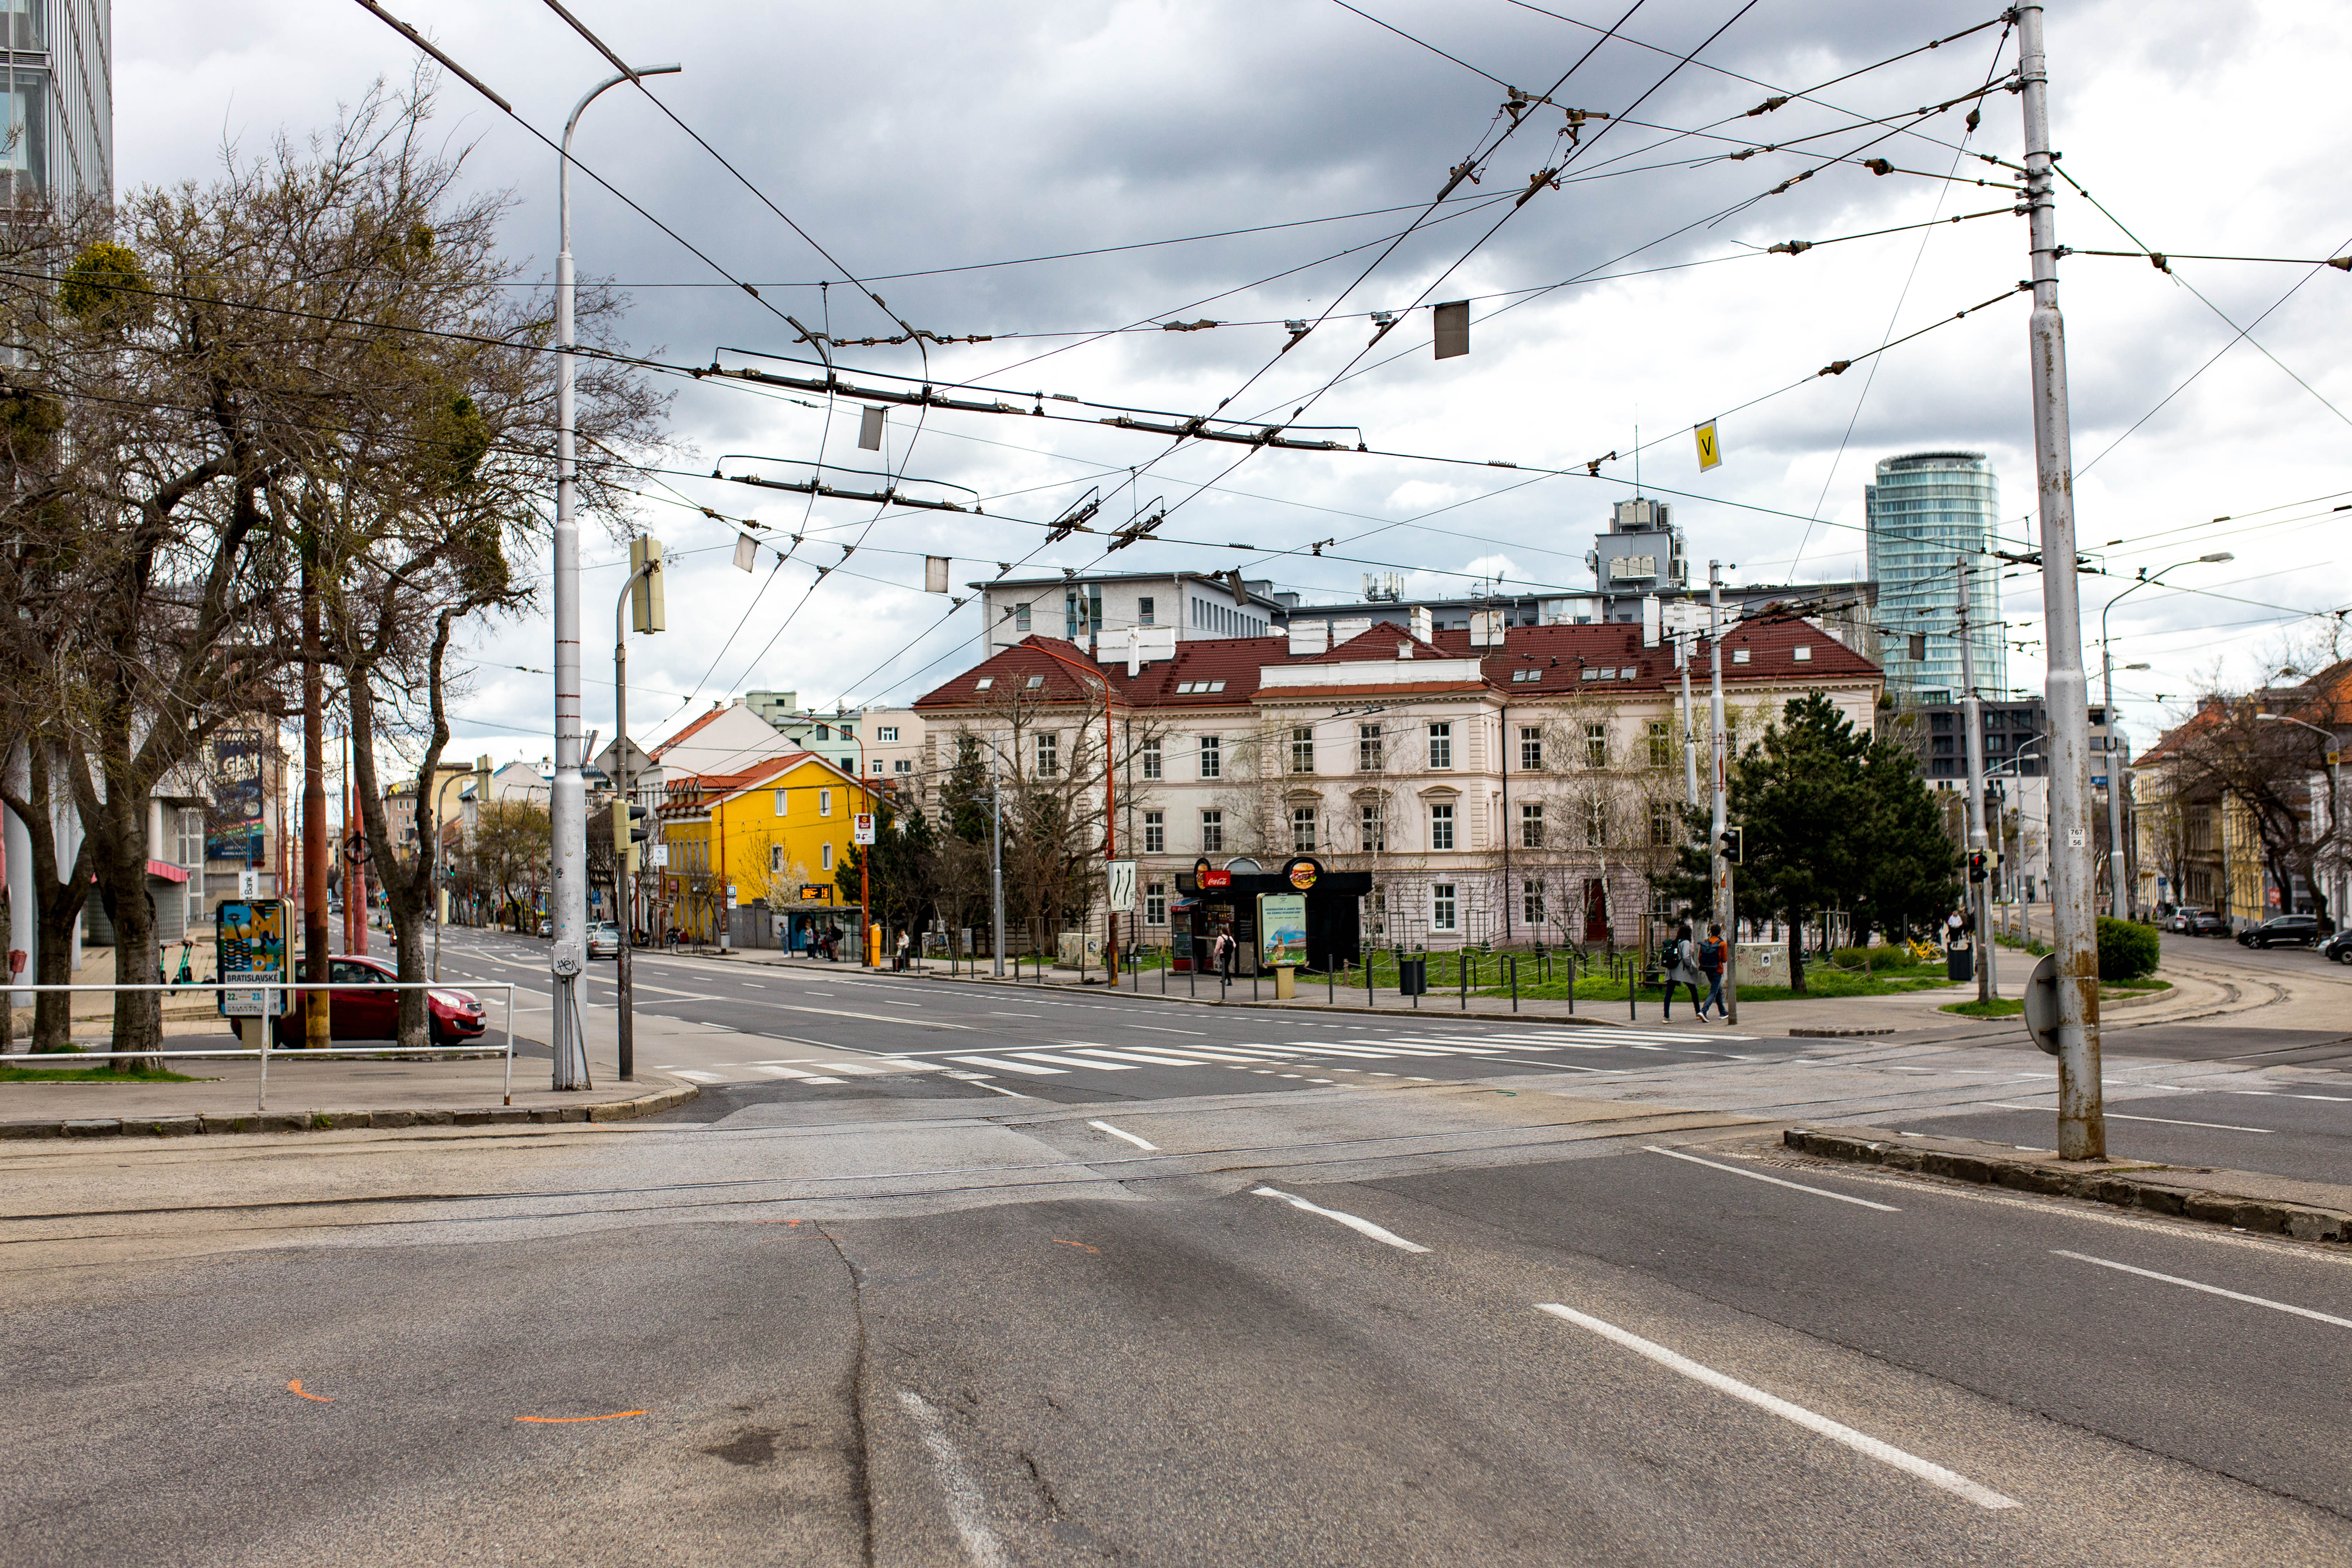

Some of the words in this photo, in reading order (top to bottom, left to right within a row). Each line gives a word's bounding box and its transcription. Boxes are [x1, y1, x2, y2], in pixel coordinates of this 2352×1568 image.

[1701, 436, 1711, 456] V
[244, 876, 252, 895] Bank
[227, 972, 278, 982] BRATISLAVSKÉ
